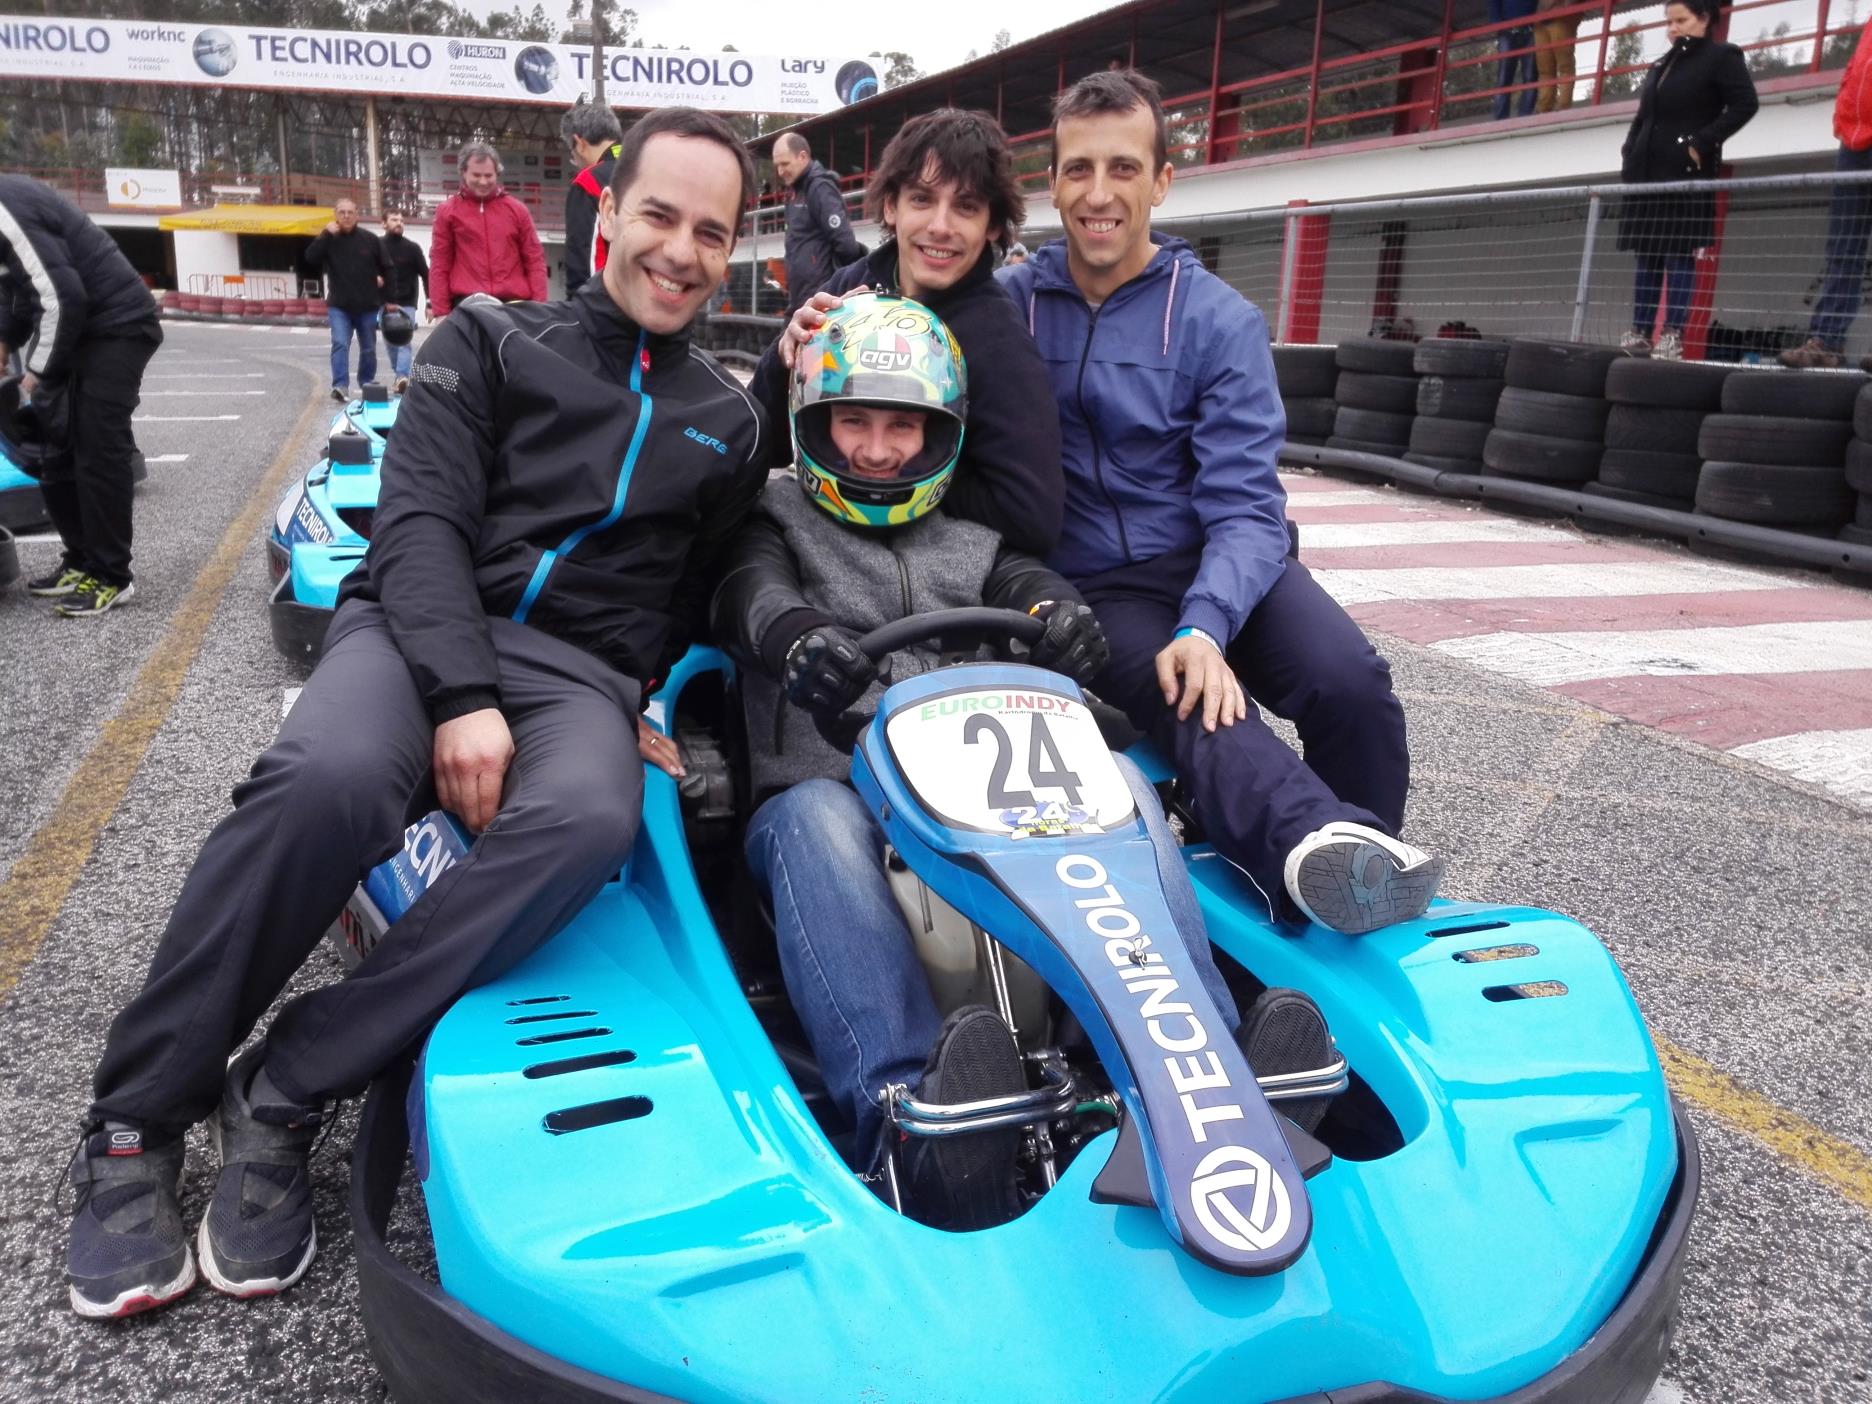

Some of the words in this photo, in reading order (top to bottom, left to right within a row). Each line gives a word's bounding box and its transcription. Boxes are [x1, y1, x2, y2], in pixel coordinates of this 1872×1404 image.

[126, 26, 186, 42] worknc
[248, 35, 432, 69] TECNIROLO
[467, 47, 503, 58] HURON
[273, 70, 329, 80] ENGENHARIA
[860, 350, 912, 370] agv
[920, 695, 1070, 721] EUROINDY
[964, 713, 1082, 809] 24
[1055, 854, 1244, 1143] TECNIROLO
